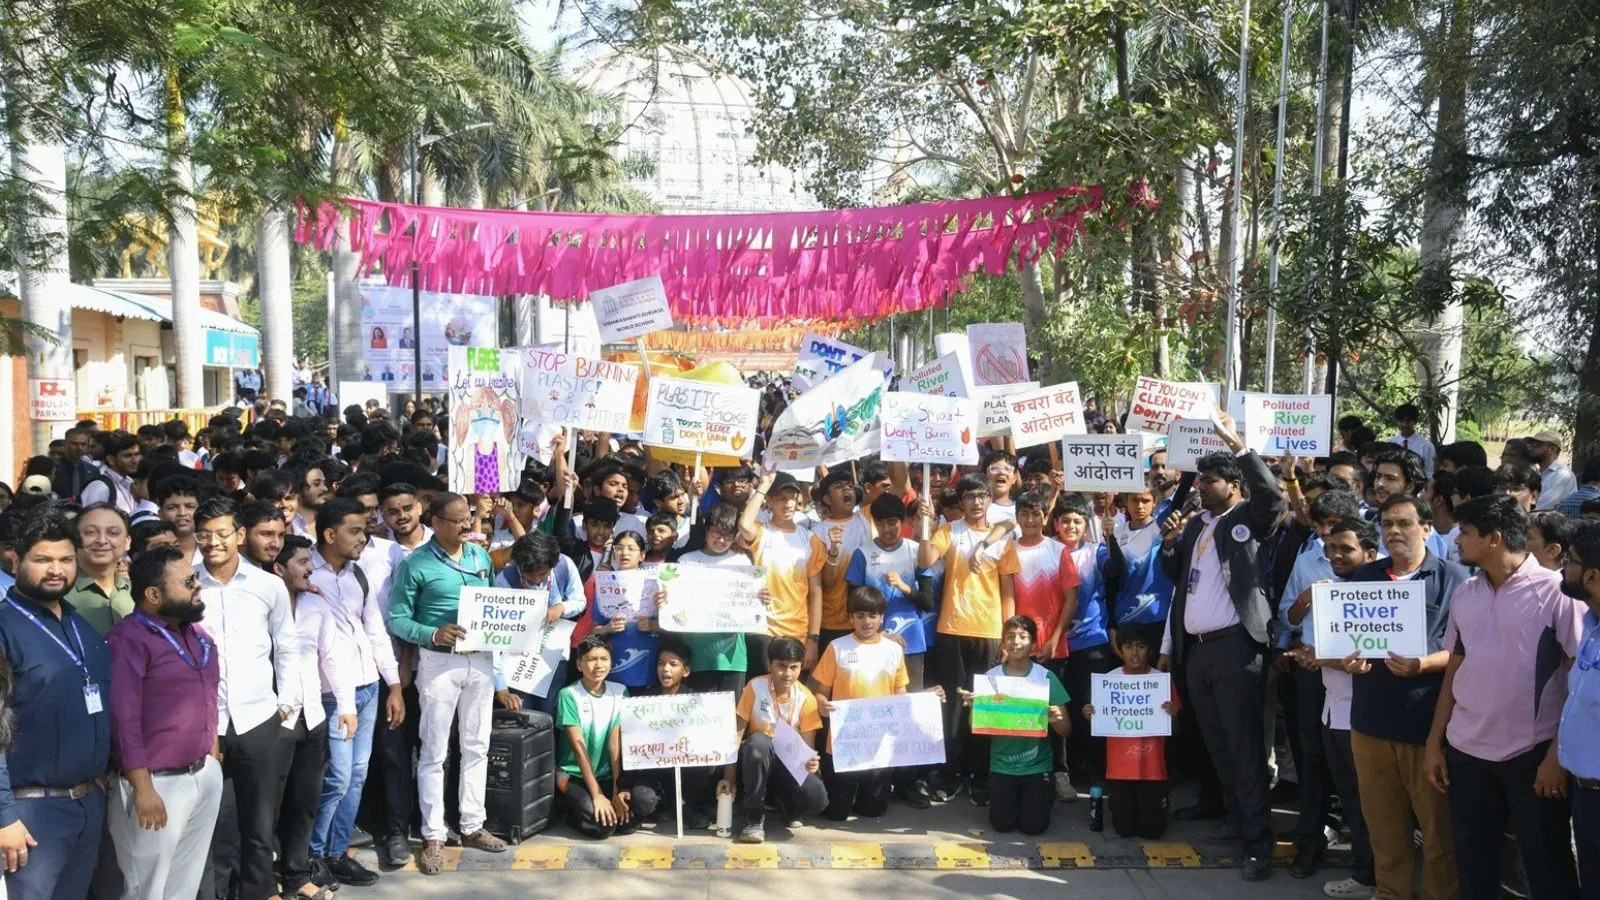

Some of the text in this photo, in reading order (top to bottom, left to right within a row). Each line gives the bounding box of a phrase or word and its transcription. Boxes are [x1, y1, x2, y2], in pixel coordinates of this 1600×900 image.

[616, 320, 655, 332] WORLD SCHOOL
[527, 350, 638, 384] STOP BURNING
[909, 363, 942, 384] Polluted
[917, 371, 950, 392] River
[1159, 382, 1178, 396] YOU
[656, 384, 722, 410] PLASTIC
[1012, 395, 1051, 414] कचरा
[1053, 389, 1075, 404] बंद
[1139, 392, 1195, 412] CLEAN IT
[1263, 400, 1310, 410] Polluted
[676, 418, 704, 428] TOXIC
[703, 409, 749, 424] SMOKE
[1021, 411, 1075, 433] आंदोलन
[1274, 411, 1317, 424] River
[1142, 420, 1166, 432] IT
[1179, 425, 1205, 434] Trash
[1259, 425, 1306, 436] Polluted
[1189, 436, 1225, 447] in Bins
[1275, 436, 1318, 450] Lives
[1068, 440, 1138, 459] कचरा बंद
[1187, 447, 1203, 456] not
[1074, 461, 1135, 480] आंदोलन
[474, 593, 536, 606] Protect the
[1330, 588, 1410, 601] Protect the
[482, 605, 526, 620] River
[1343, 602, 1399, 618] River
[470, 620, 527, 632] it Protects
[1330, 621, 1404, 632] it Protects
[483, 631, 513, 645] You
[1349, 634, 1388, 650] You
[512, 659, 528, 682] Stop
[524, 656, 540, 680] Start
[1102, 680, 1159, 690] Protect the
[1111, 692, 1151, 704] River
[1103, 706, 1154, 716] it Protects
[1115, 717, 1144, 730] You
